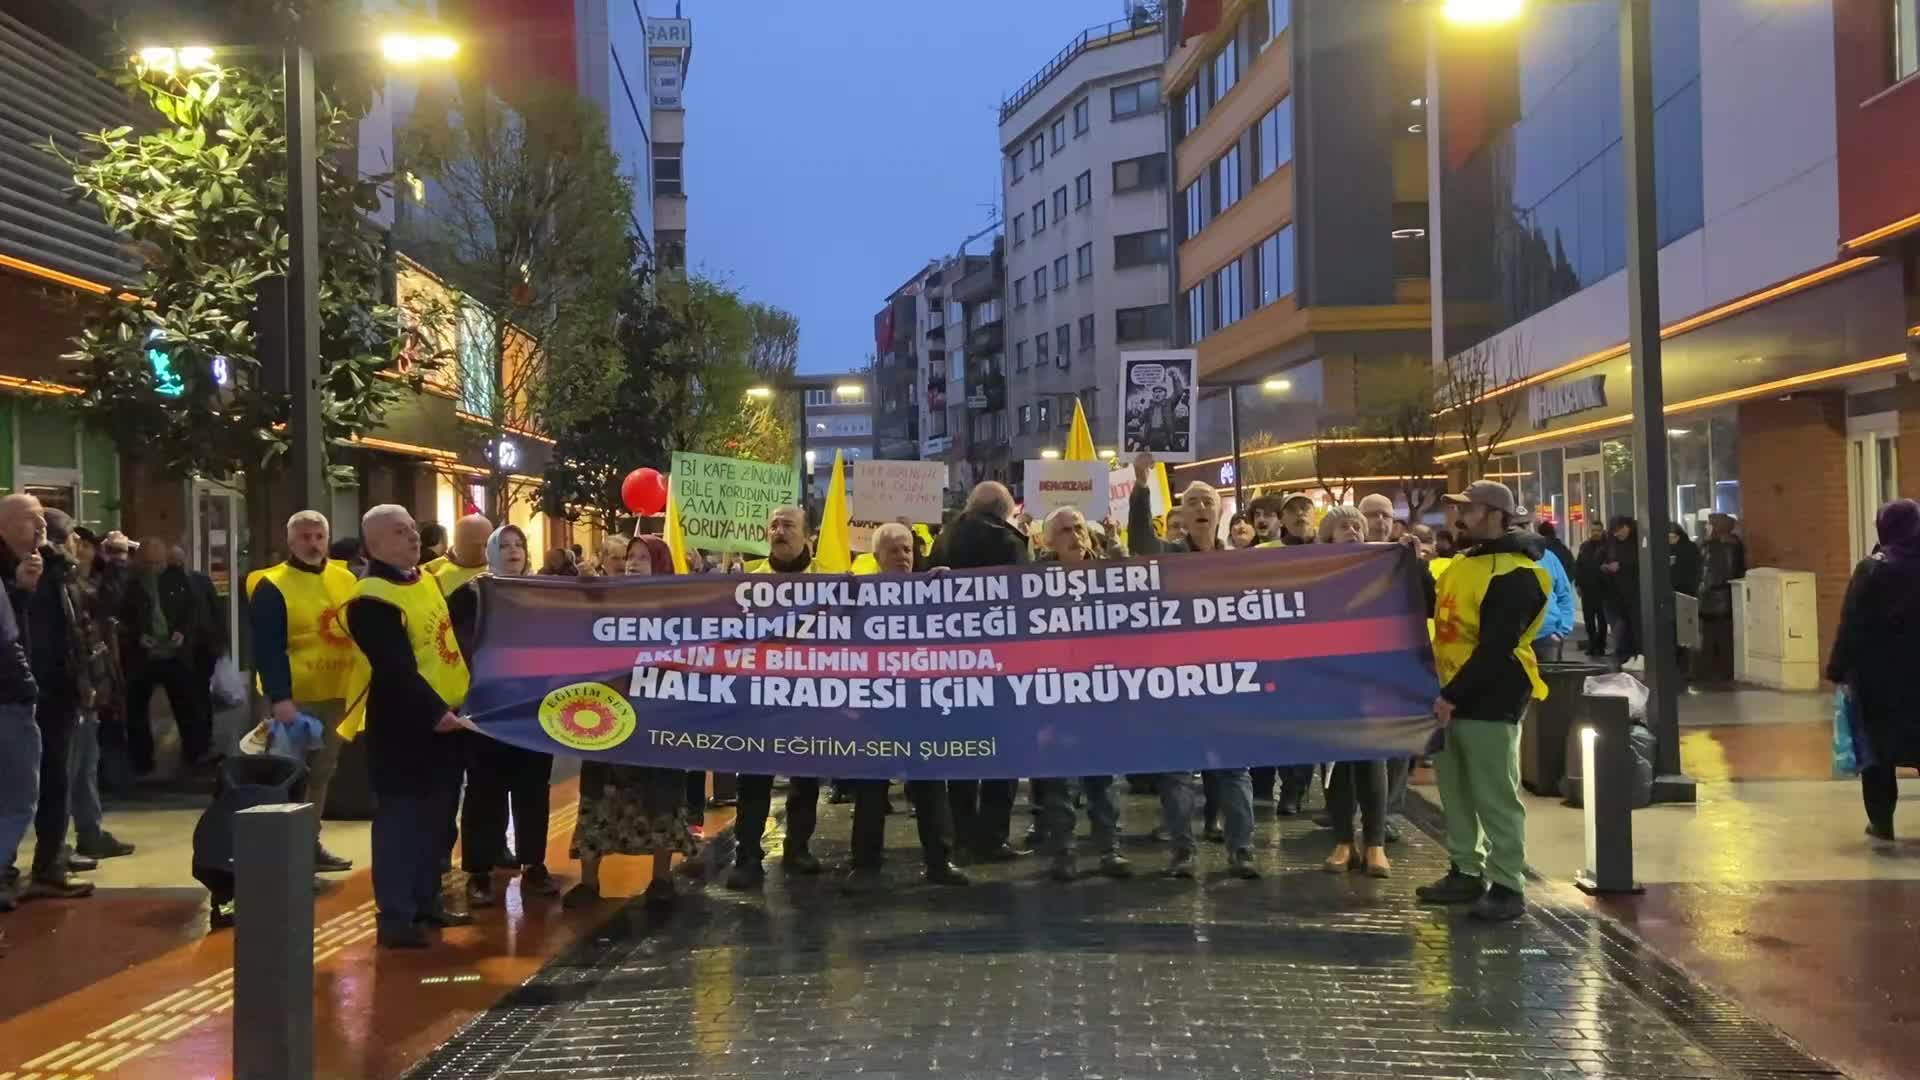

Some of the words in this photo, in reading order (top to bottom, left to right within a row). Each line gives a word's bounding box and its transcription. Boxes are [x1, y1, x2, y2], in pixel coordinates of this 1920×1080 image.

[681, 459, 697, 476] Bİ
[703, 463, 736, 480] KAFE
[681, 479, 713, 497] BİLE
[719, 484, 792, 505] KORUDUNUZ
[681, 497, 726, 515] AMA
[736, 501, 769, 520] BİZİ
[735, 574, 1009, 613] ÇOCUKLARIMIZIN
[1021, 560, 1161, 601] DÜŞLERİ
[593, 611, 851, 645] GENÇLERİMİZİN
[864, 603, 1017, 640] GELECEĞİ
[1029, 596, 1181, 635] SAHİPSİZ
[1193, 589, 1306, 623] DEĞİL!
[635, 646, 715, 666] AKLIN
[724, 648, 756, 669] VE
[765, 648, 868, 672] BİLİMİN
[878, 648, 1003, 676] IŞIĞINDA,
[629, 666, 737, 704] HALK
[750, 676, 906, 708] İRADESİ
[921, 674, 994, 715] İÇİN
[1008, 661, 1277, 707] YÜRÜYORUZ.
[648, 729, 765, 753] TRABZON
[774, 735, 912, 758] EĞİTİM-SEN
[919, 736, 996, 760] ŞUBESİ
